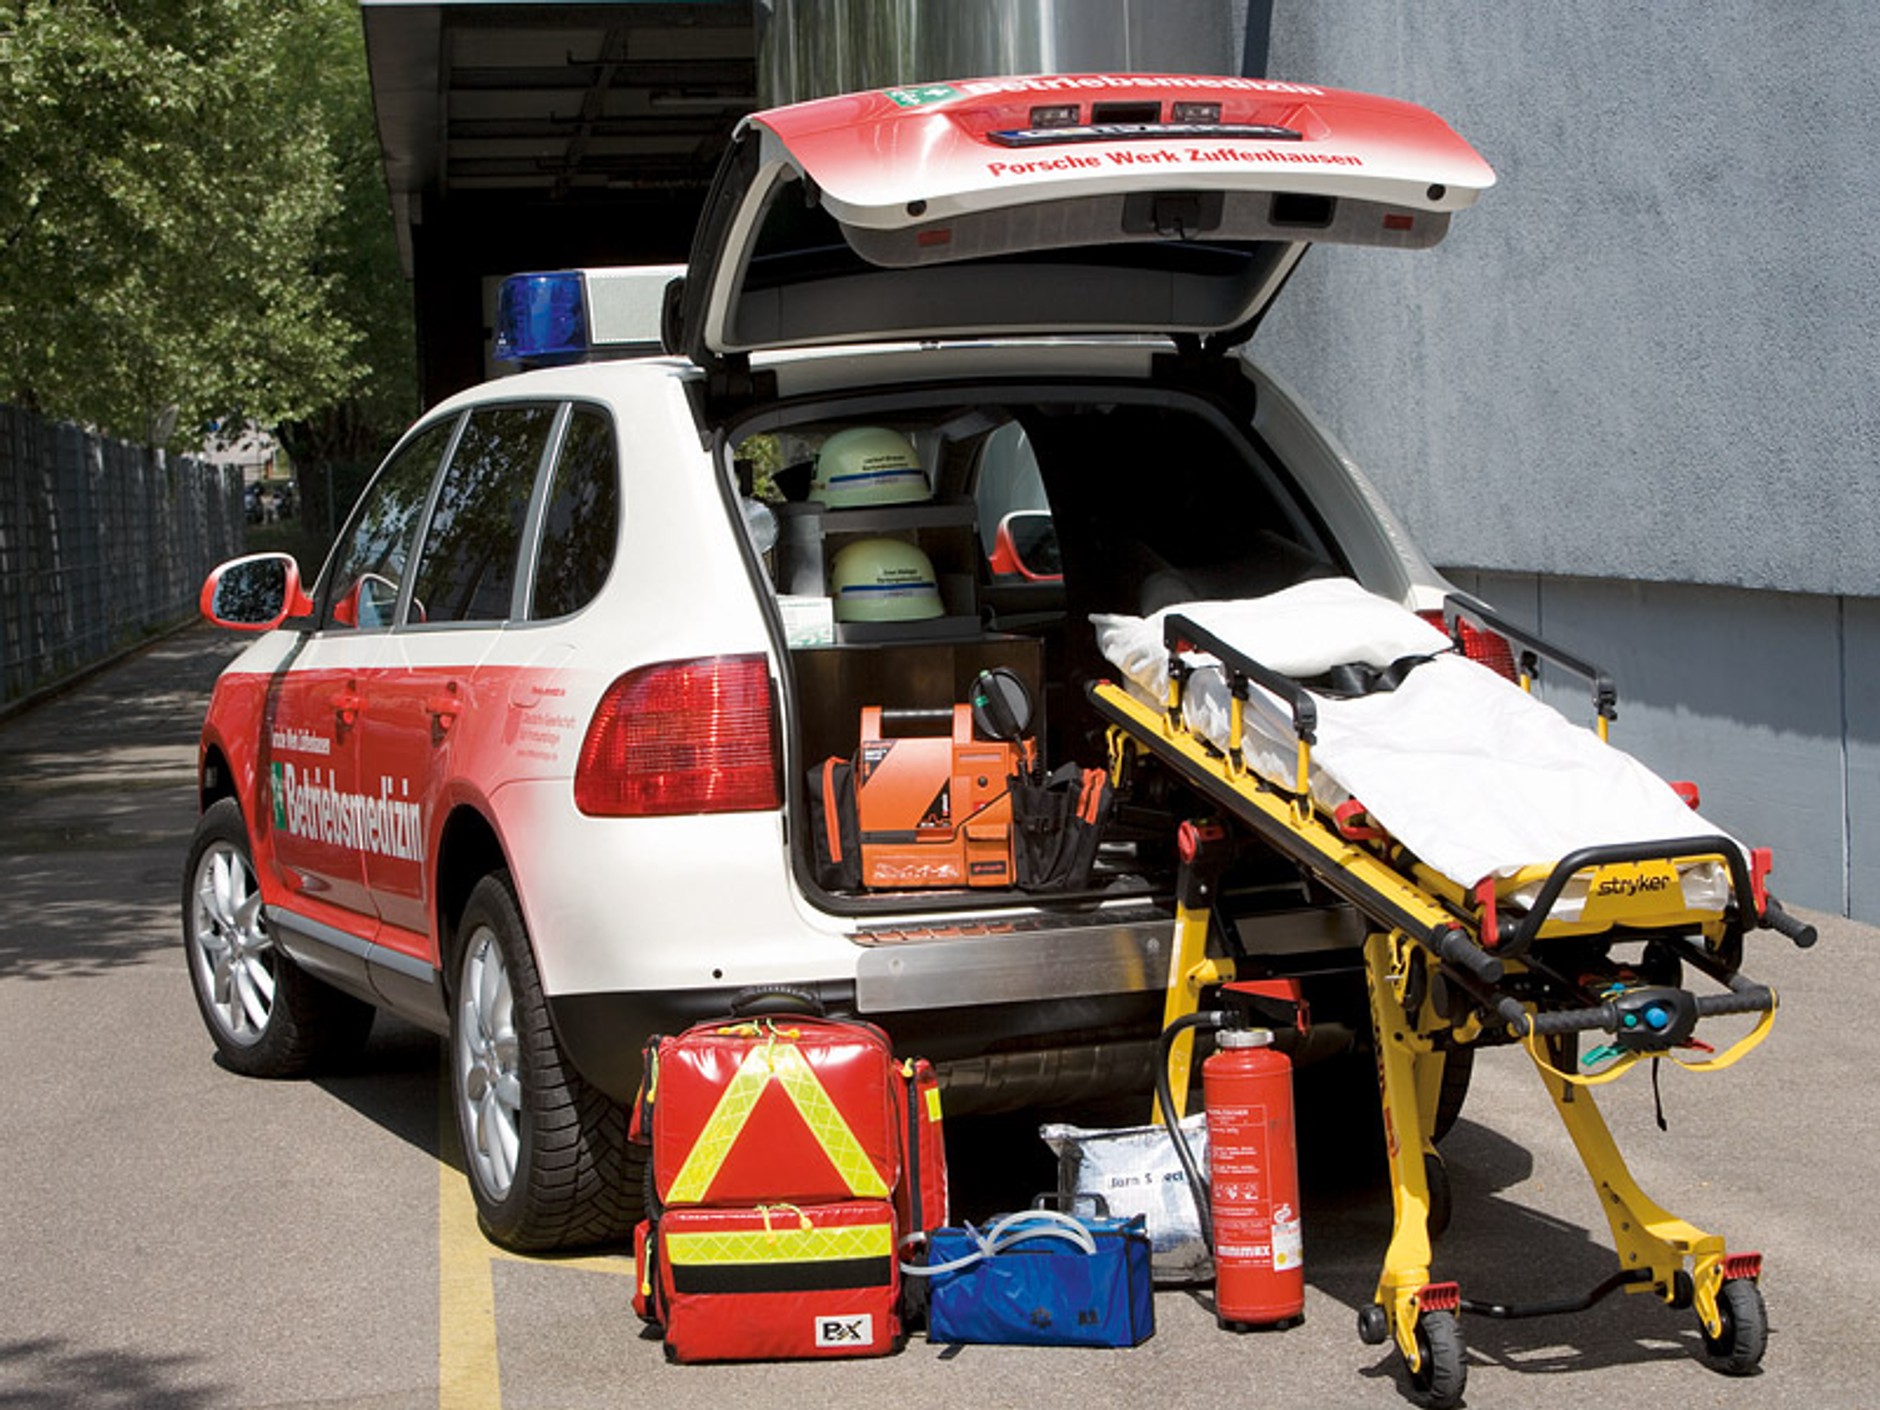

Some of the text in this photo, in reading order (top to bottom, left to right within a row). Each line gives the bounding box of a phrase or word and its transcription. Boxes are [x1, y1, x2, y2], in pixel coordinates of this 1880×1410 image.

[961, 75, 1325, 97] Betriebsmedizin
[986, 147, 1364, 177] Porsche Werk Zuffenhausen
[284, 762, 424, 862] Betriebsmedizin
[1597, 873, 1670, 896] stryker
